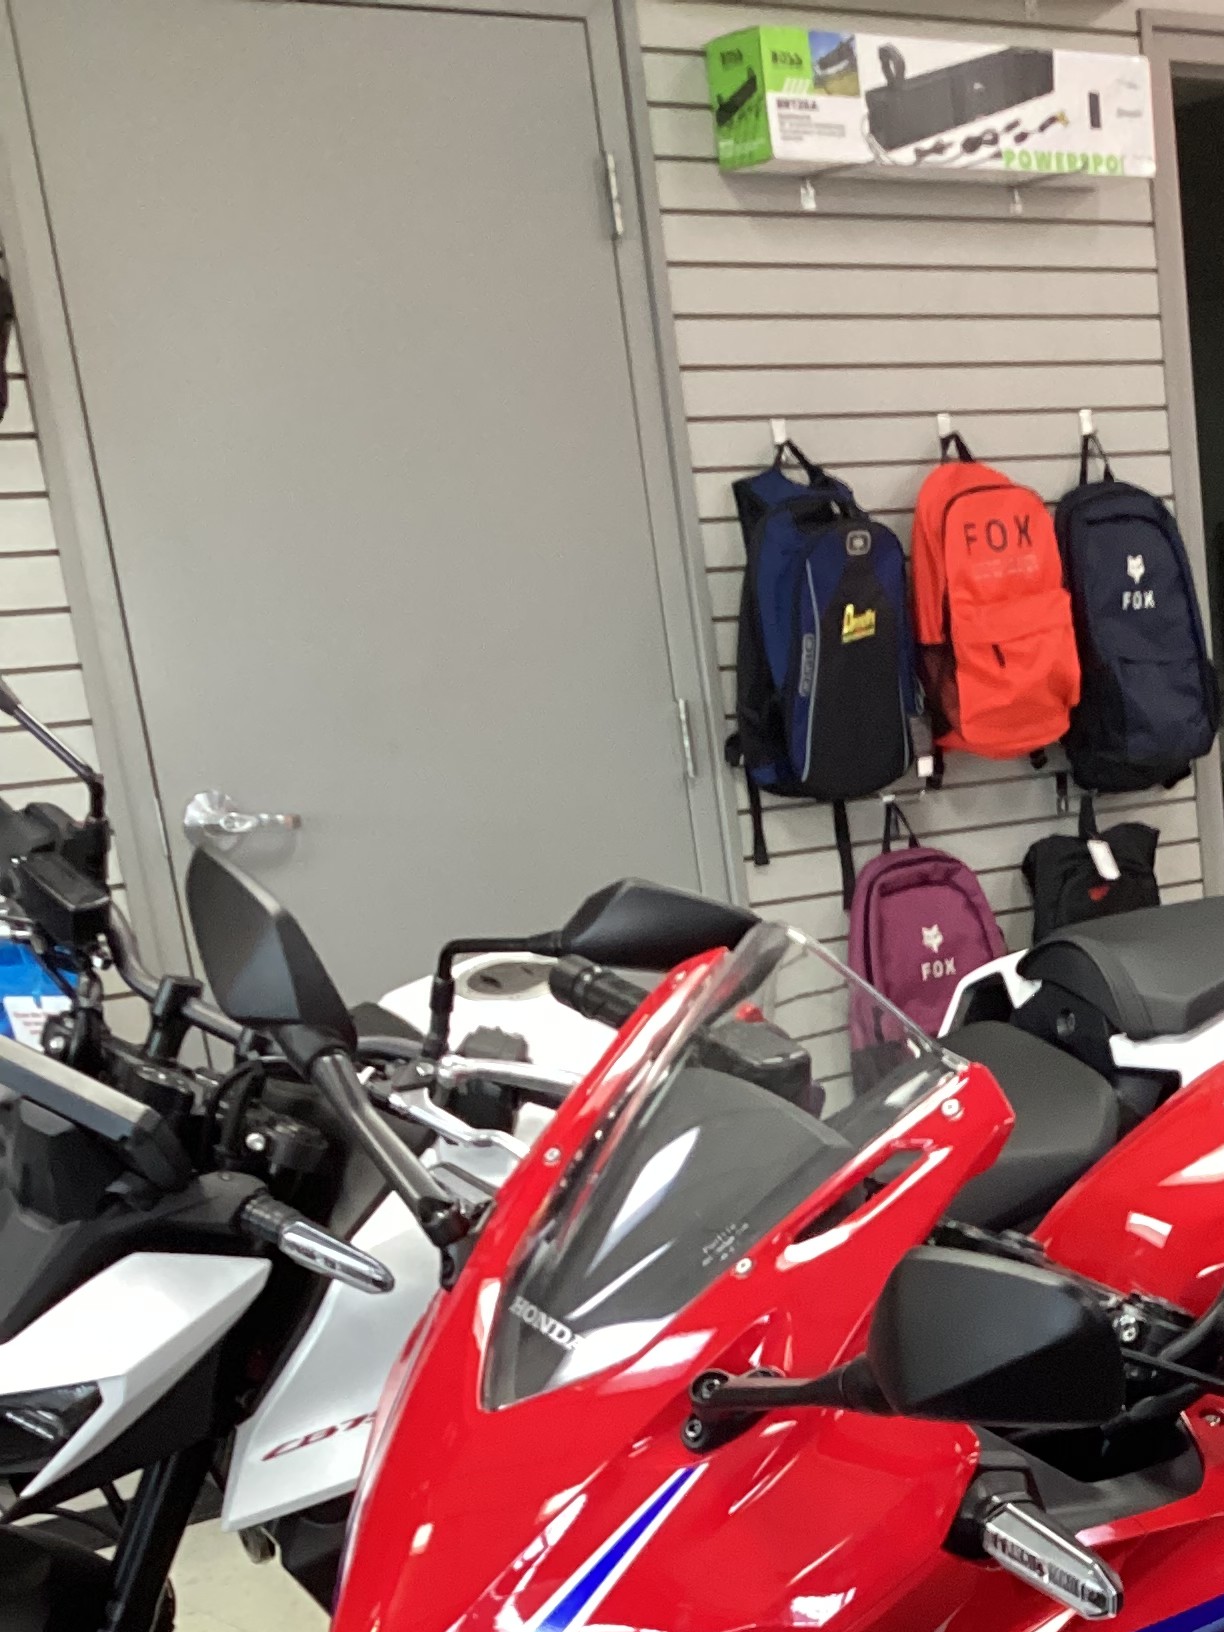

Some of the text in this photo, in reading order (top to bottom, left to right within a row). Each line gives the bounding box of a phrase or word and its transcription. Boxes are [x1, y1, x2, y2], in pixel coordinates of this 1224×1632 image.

[1002, 149, 1125, 174] POWERSPO
[963, 514, 1034, 556] FOX
[1122, 589, 1156, 611] FOX
[921, 957, 957, 982] FOX
